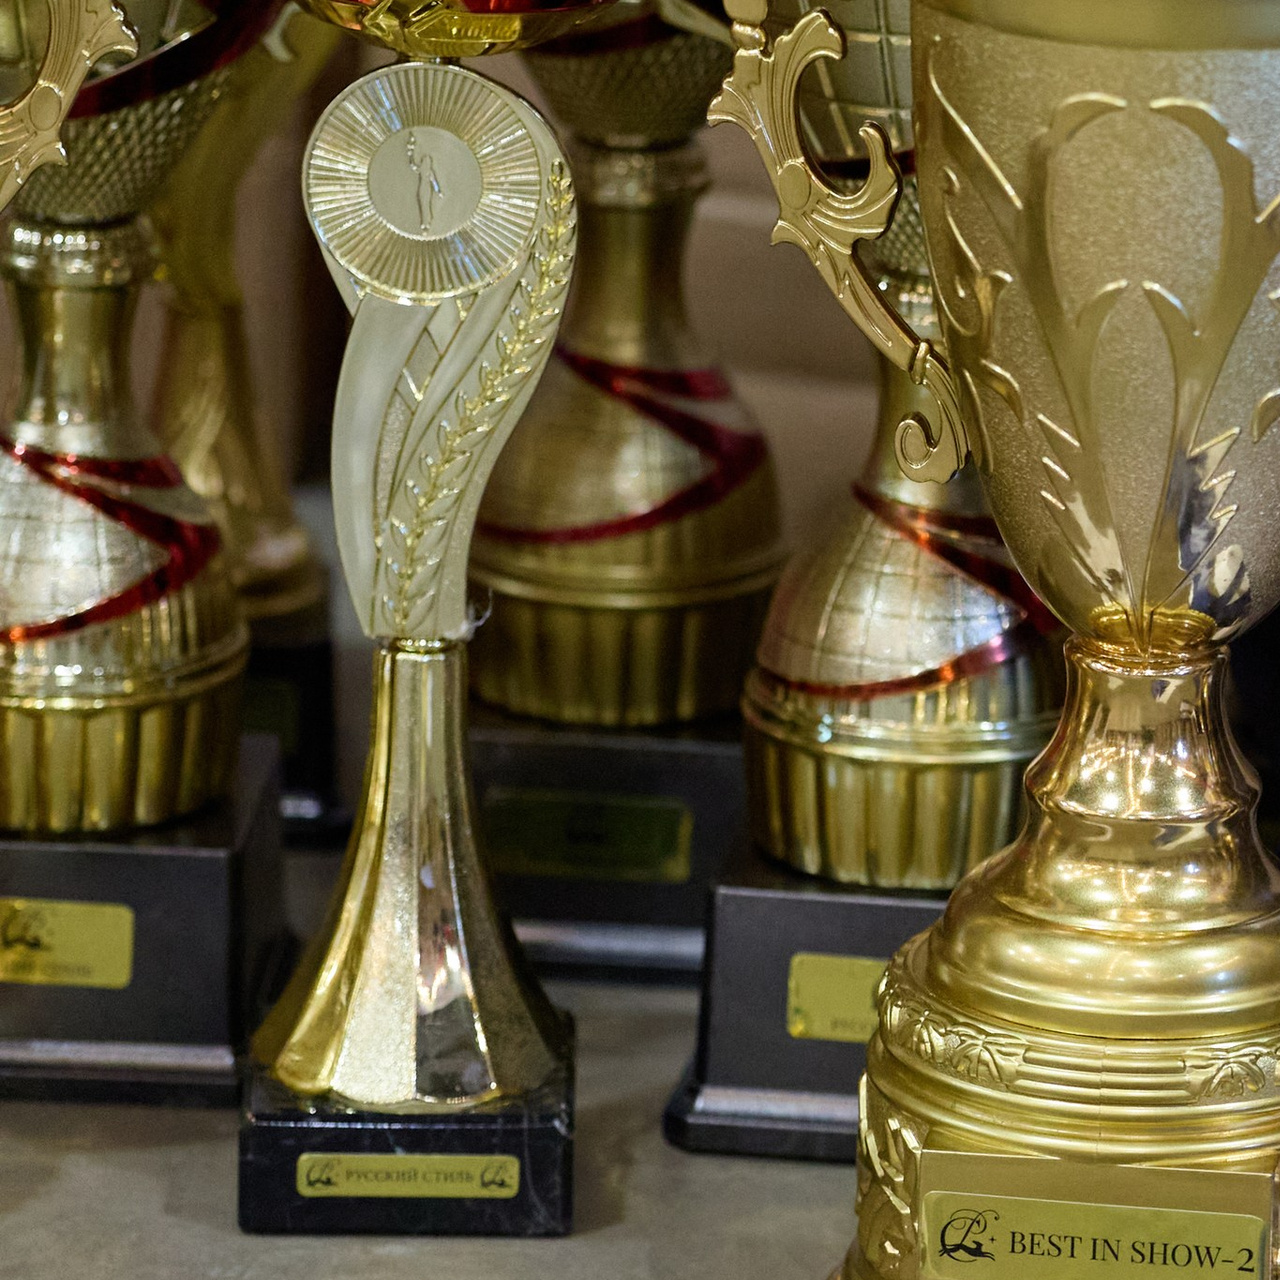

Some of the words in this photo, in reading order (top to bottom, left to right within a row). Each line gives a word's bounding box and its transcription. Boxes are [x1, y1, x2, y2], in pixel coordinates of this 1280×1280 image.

[1009, 1230, 1083, 1258] BEST
[1090, 1237, 1121, 1262] IN
[1130, 1240, 1256, 1273] SHOW-2
